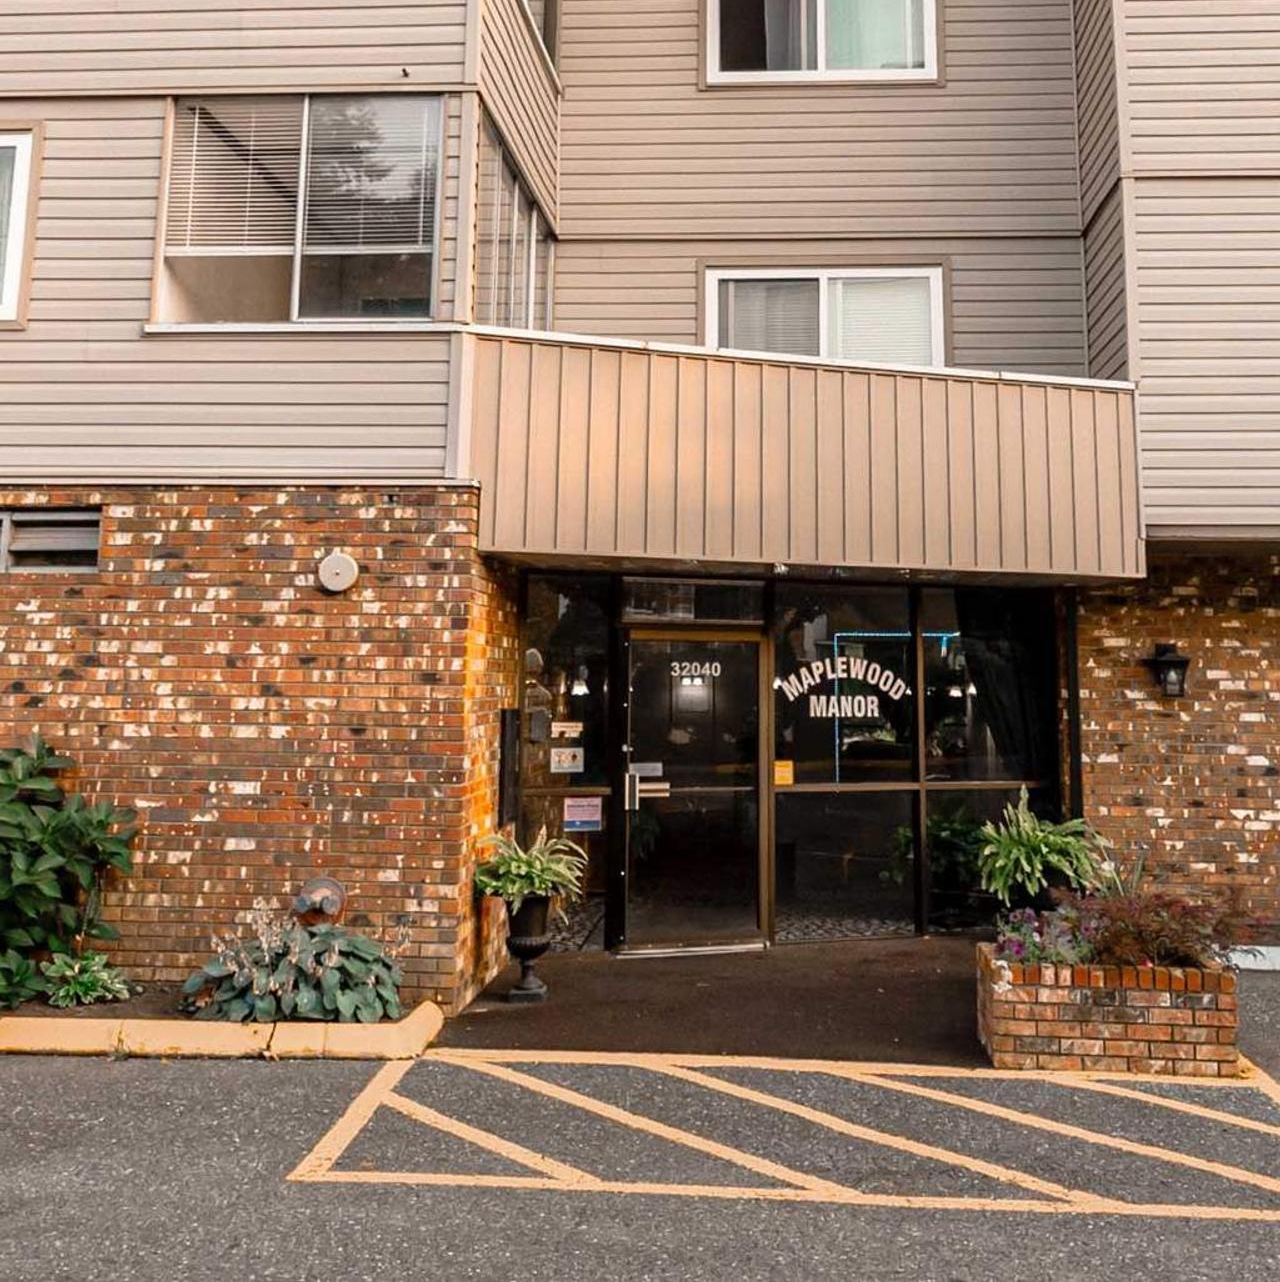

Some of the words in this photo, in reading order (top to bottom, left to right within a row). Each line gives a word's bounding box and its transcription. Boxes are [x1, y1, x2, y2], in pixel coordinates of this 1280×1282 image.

[670, 662, 721, 677] 32040
[782, 656, 906, 701] MAPLEWOOD
[809, 695, 879, 717] MANOR
